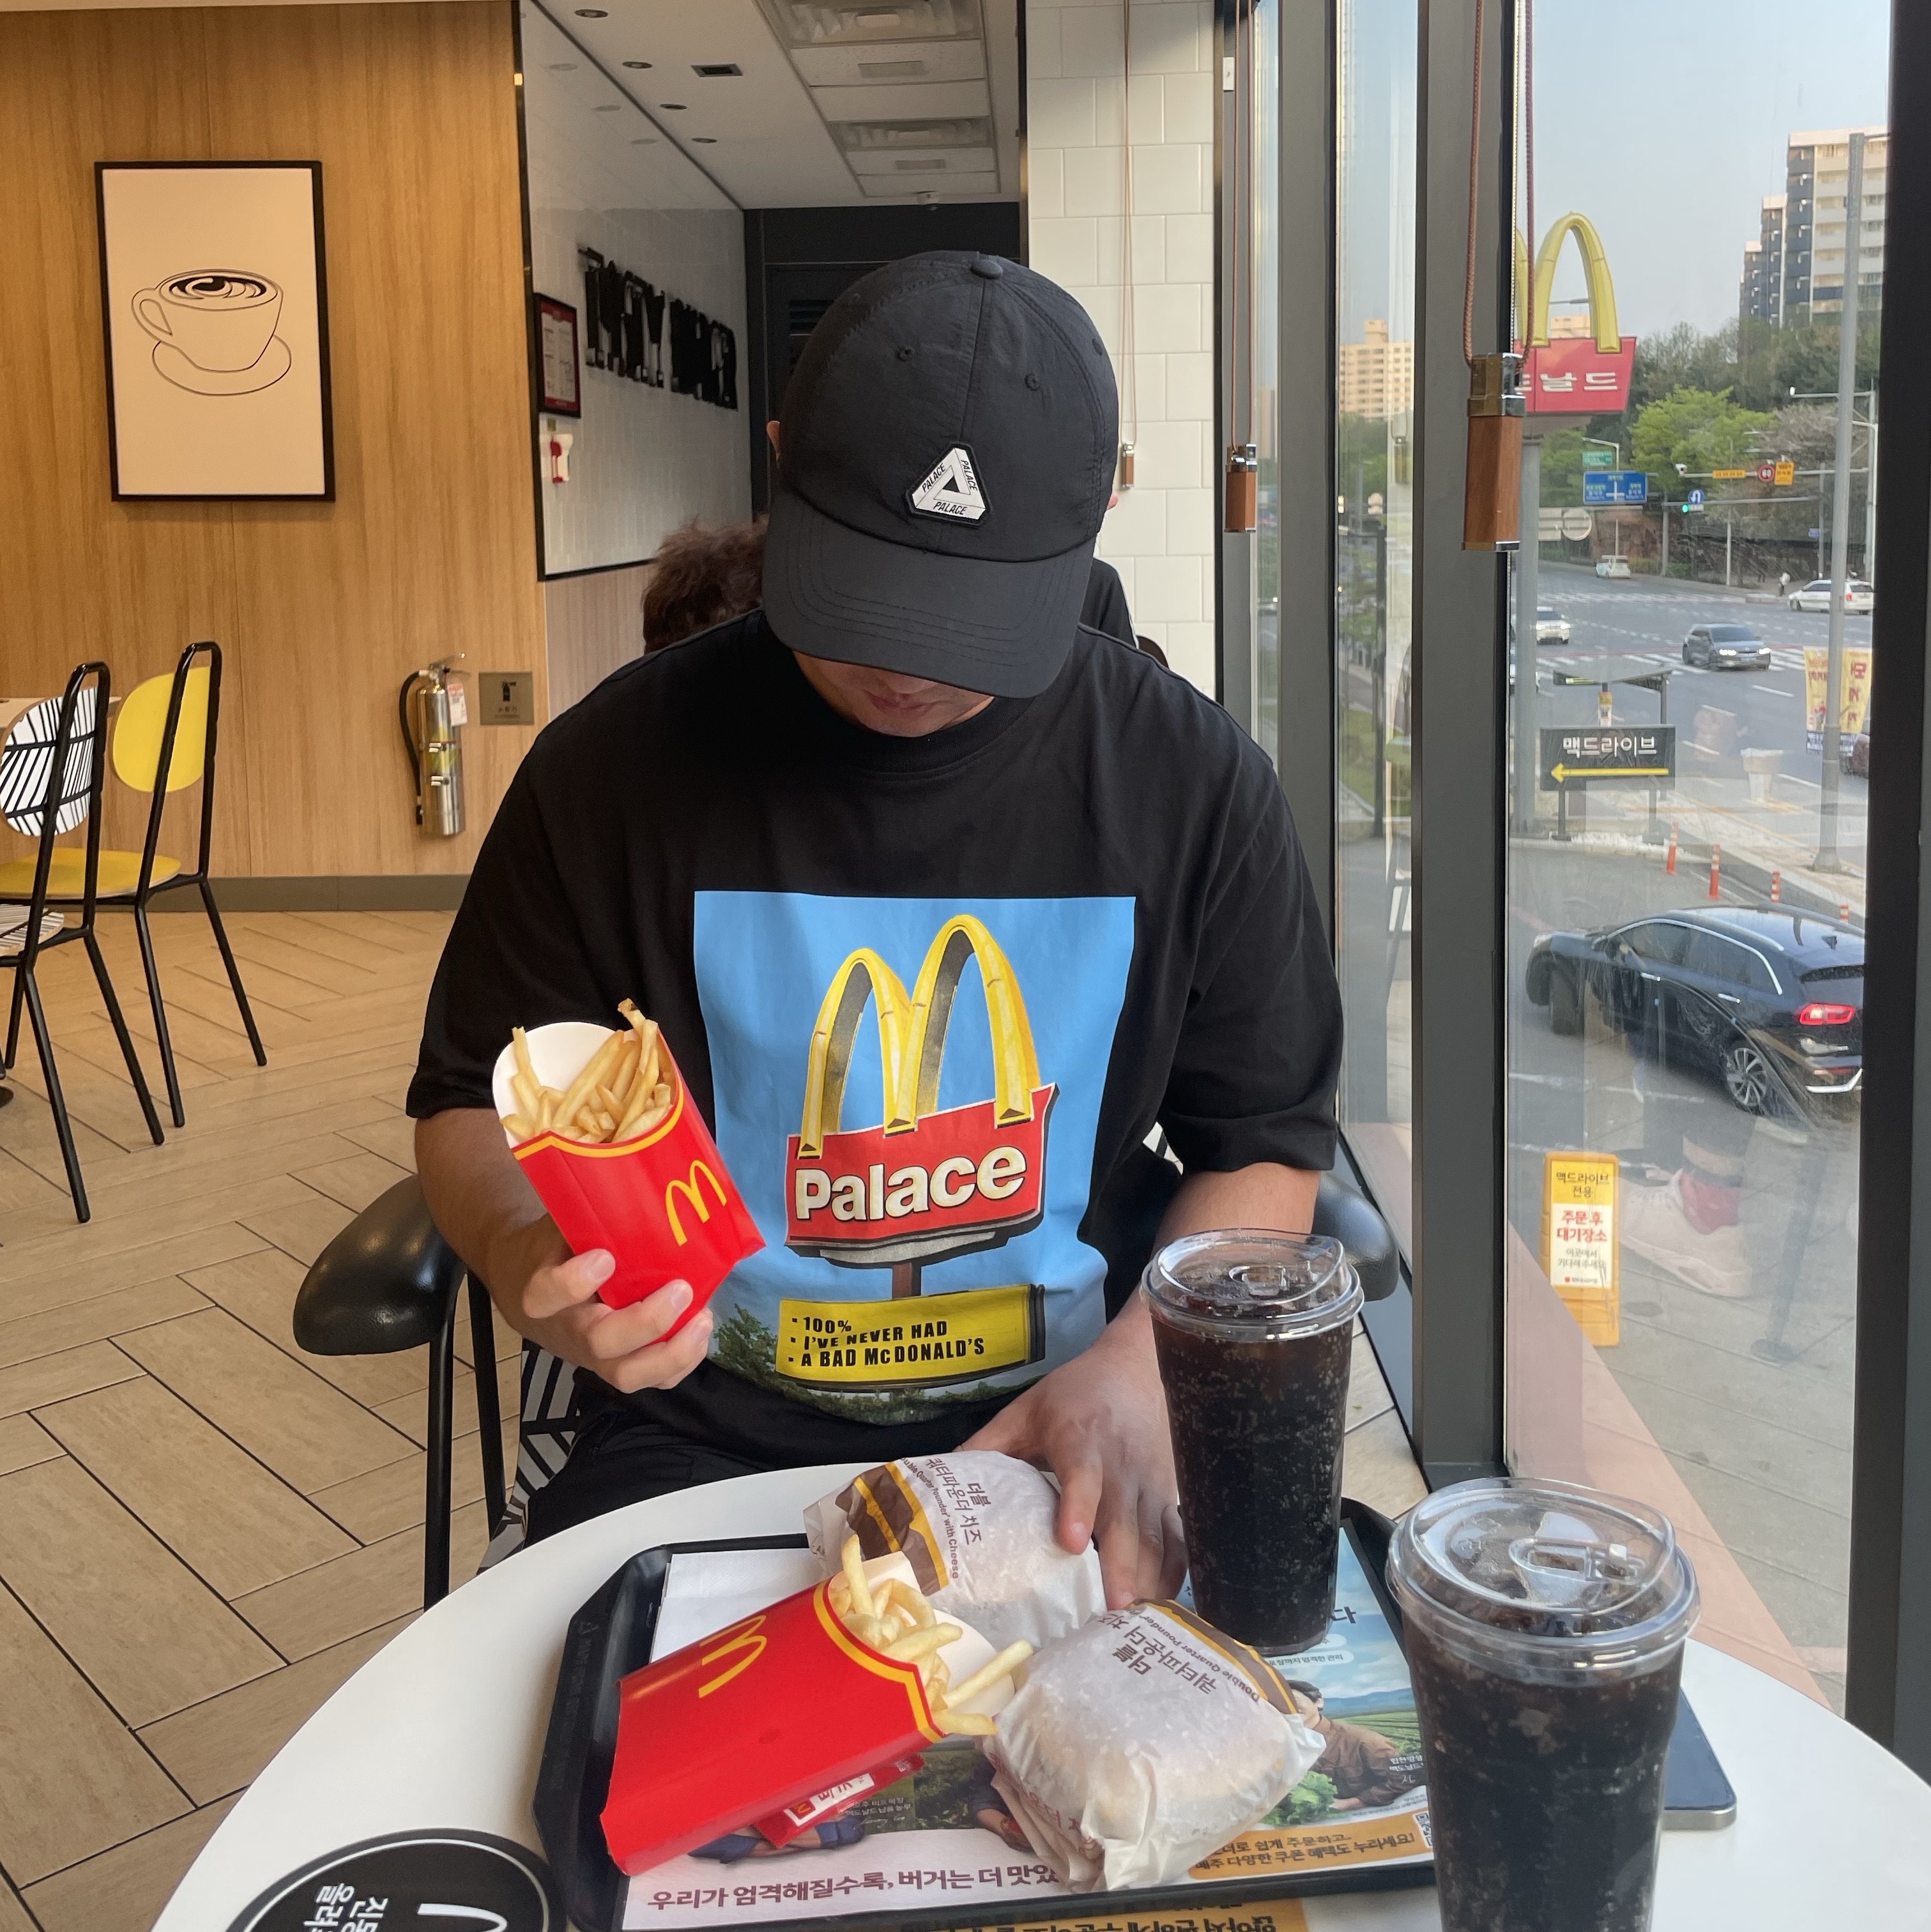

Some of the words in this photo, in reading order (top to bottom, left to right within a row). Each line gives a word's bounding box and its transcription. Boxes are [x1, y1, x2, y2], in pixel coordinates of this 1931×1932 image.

[1515, 372, 1618, 392] 날드
[922, 463, 946, 492] PALACE
[961, 459, 979, 491] PALACE
[933, 501, 968, 515] PALACE
[1562, 736, 1657, 759] 맥드라이브
[795, 1145, 1027, 1222] Palace
[1556, 1171, 1610, 1185] 맥드라이브
[1573, 1185, 1592, 1198] 전용
[1561, 1210, 1588, 1225] 주문
[1589, 1211, 1603, 1226] 후
[1557, 1228, 1607, 1242] 대기장소
[803, 1316, 852, 1334] 100%
[804, 1335, 839, 1350] I'VE
[846, 1327, 903, 1345] NEVER
[911, 1320, 947, 1339] HAD
[801, 1353, 813, 1367] A
[819, 1350, 857, 1367] BAD
[864, 1337, 985, 1365] McDONALD'S
[900, 1457, 918, 1473] ouble
[916, 1470, 935, 1488] Quarter
[926, 1457, 973, 1511] 쿼터파운더
[960, 1514, 982, 1546] 치즈
[966, 1482, 992, 1507] 더블
[943, 1518, 956, 1539] with
[949, 1537, 959, 1579] Cheese
[1111, 1643, 1152, 1675] 더블
[1123, 1625, 1217, 1694] 쿼터파운더
[1180, 1645, 1221, 1673] Quarter
[1222, 1670, 1260, 1703] Double
[1227, 1853, 1272, 1866] 다양한
[1275, 1848, 1306, 1863] 쿠폰
[1255, 1838, 1285, 1852] 쉽게
[648, 1887, 729, 1910] 우리가
[733, 1871, 894, 1906] 엄격해질수록,
[898, 1869, 975, 1890] 버거는
[979, 1866, 1002, 1887] 더
